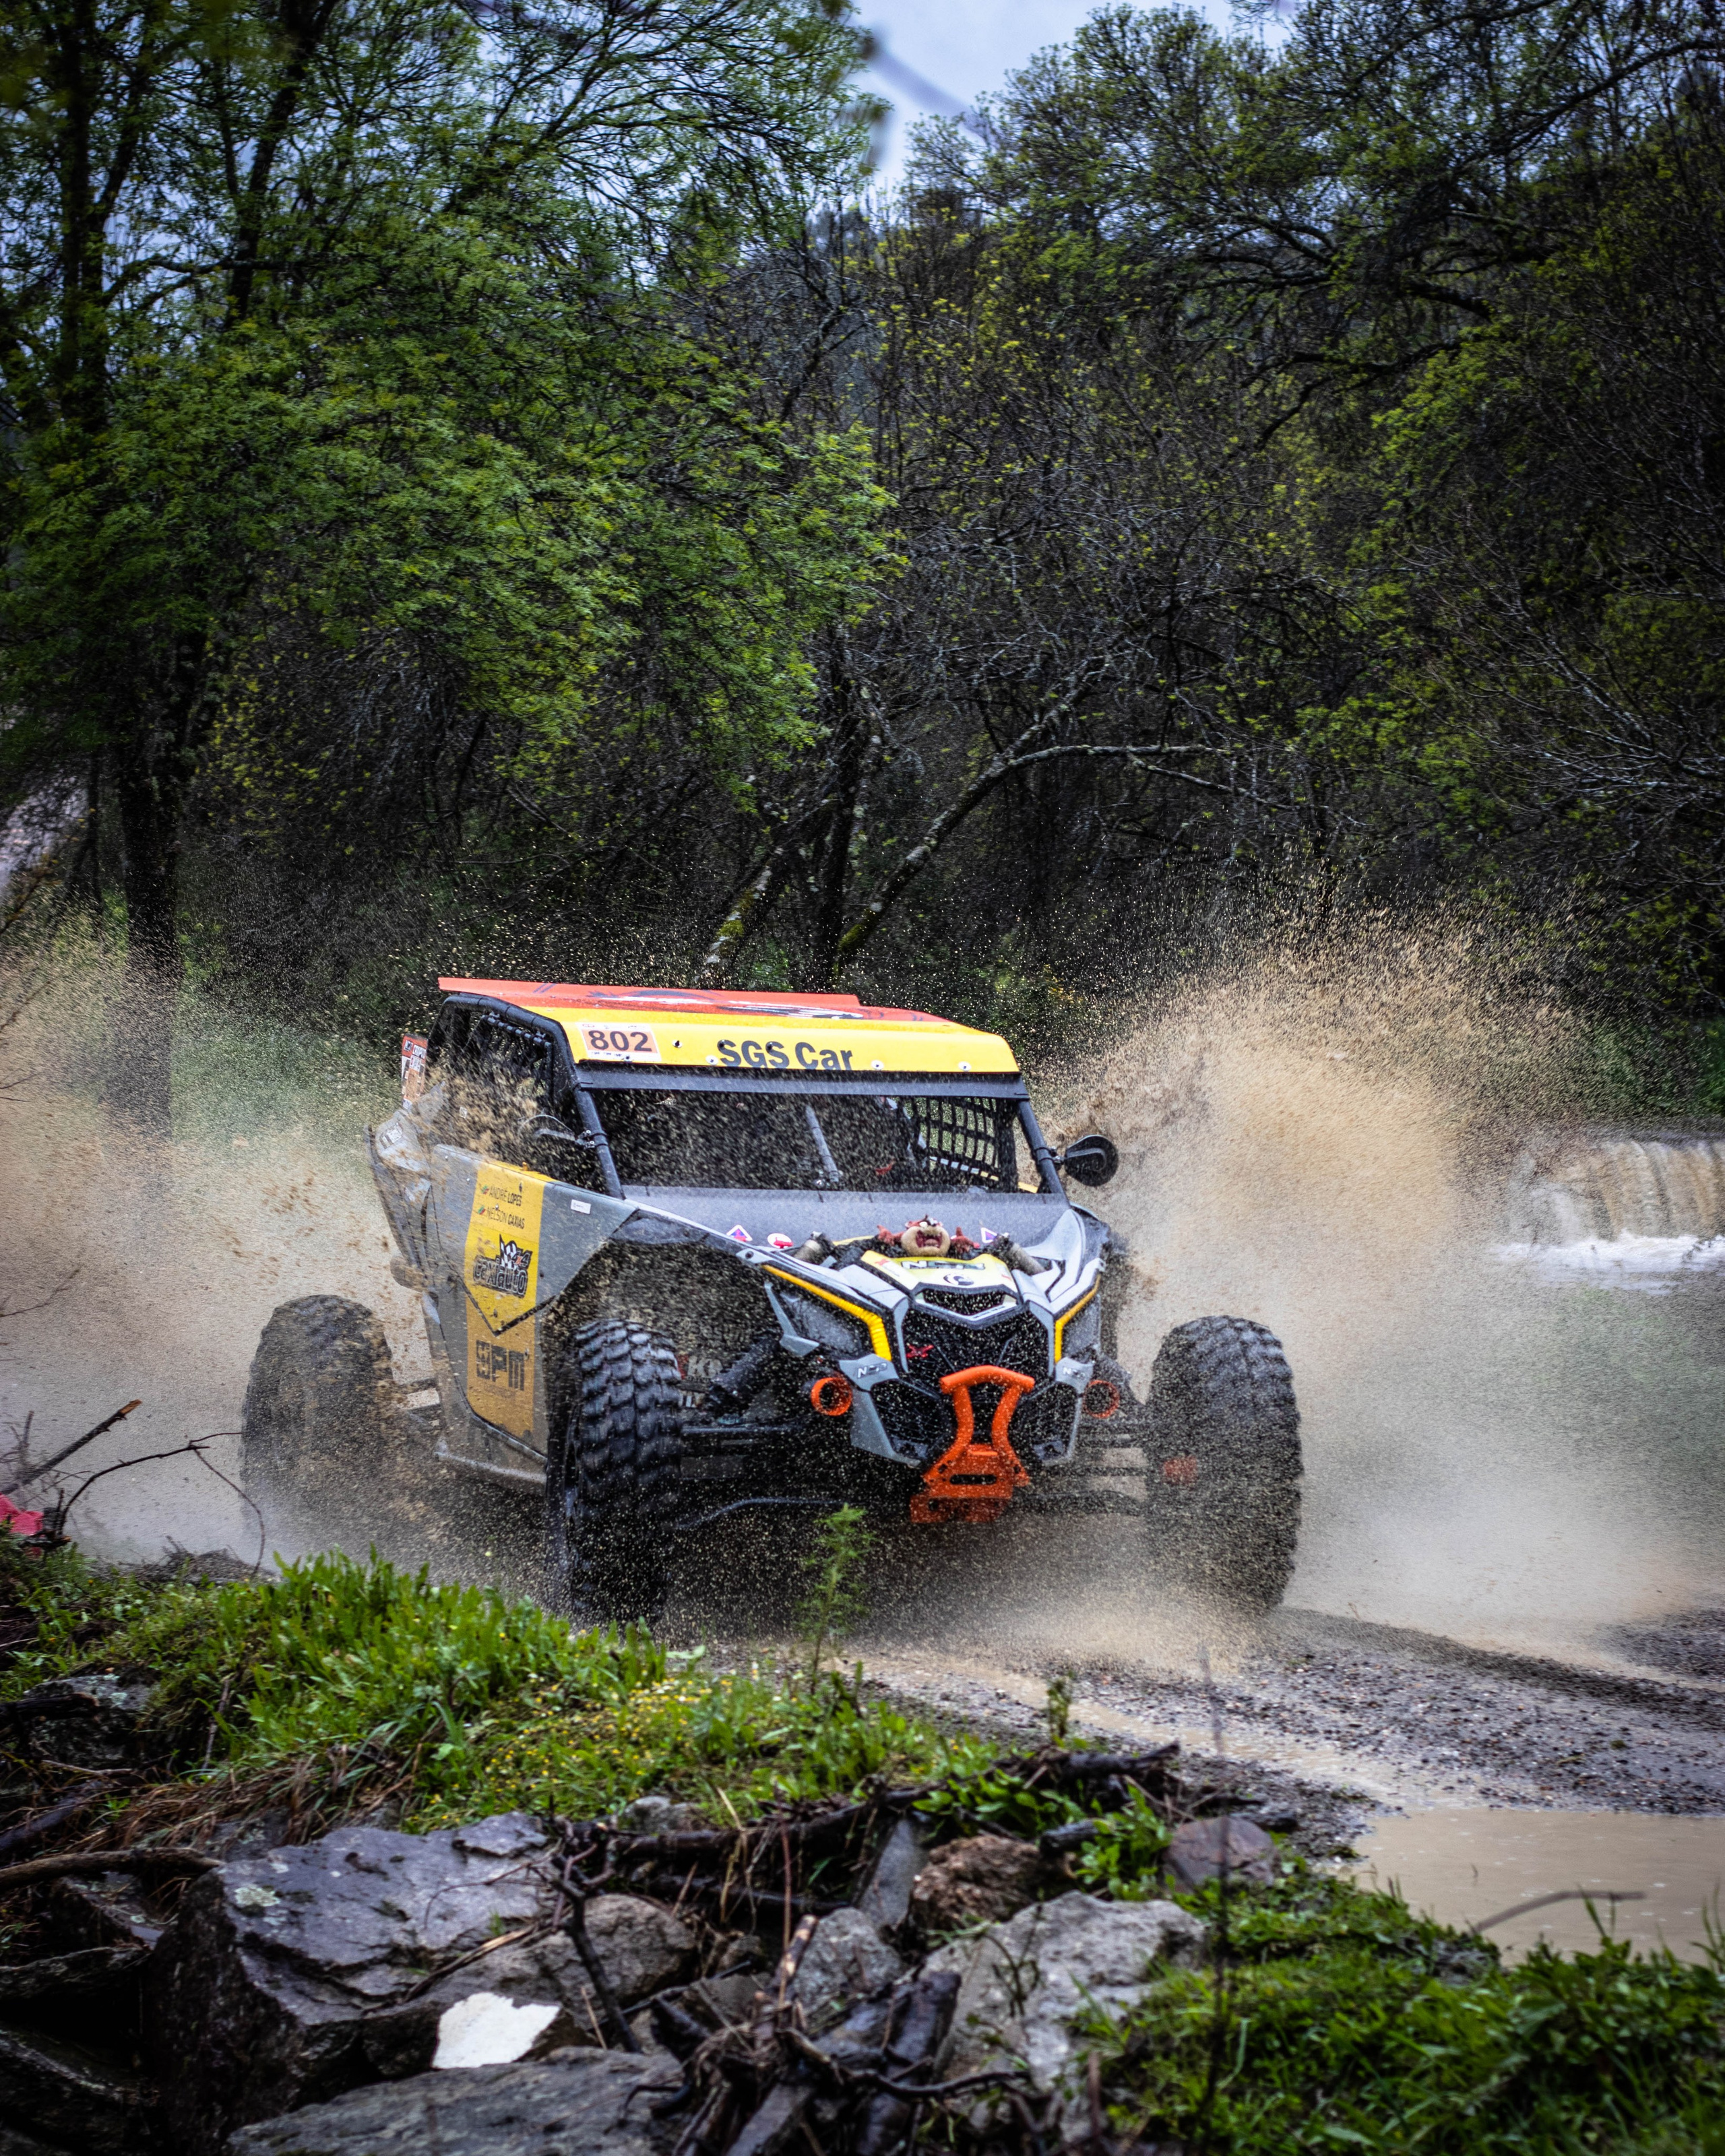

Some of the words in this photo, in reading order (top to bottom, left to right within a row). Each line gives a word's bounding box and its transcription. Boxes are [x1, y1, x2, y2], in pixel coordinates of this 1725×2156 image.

[588, 1030, 652, 1052] 802
[717, 1040, 790, 1069] SGS
[795, 1042, 852, 1071] Car
[507, 1193, 522, 1207] LOPES
[487, 1206, 507, 1223] NELSON
[508, 1213, 525, 1230] CAXIAS
